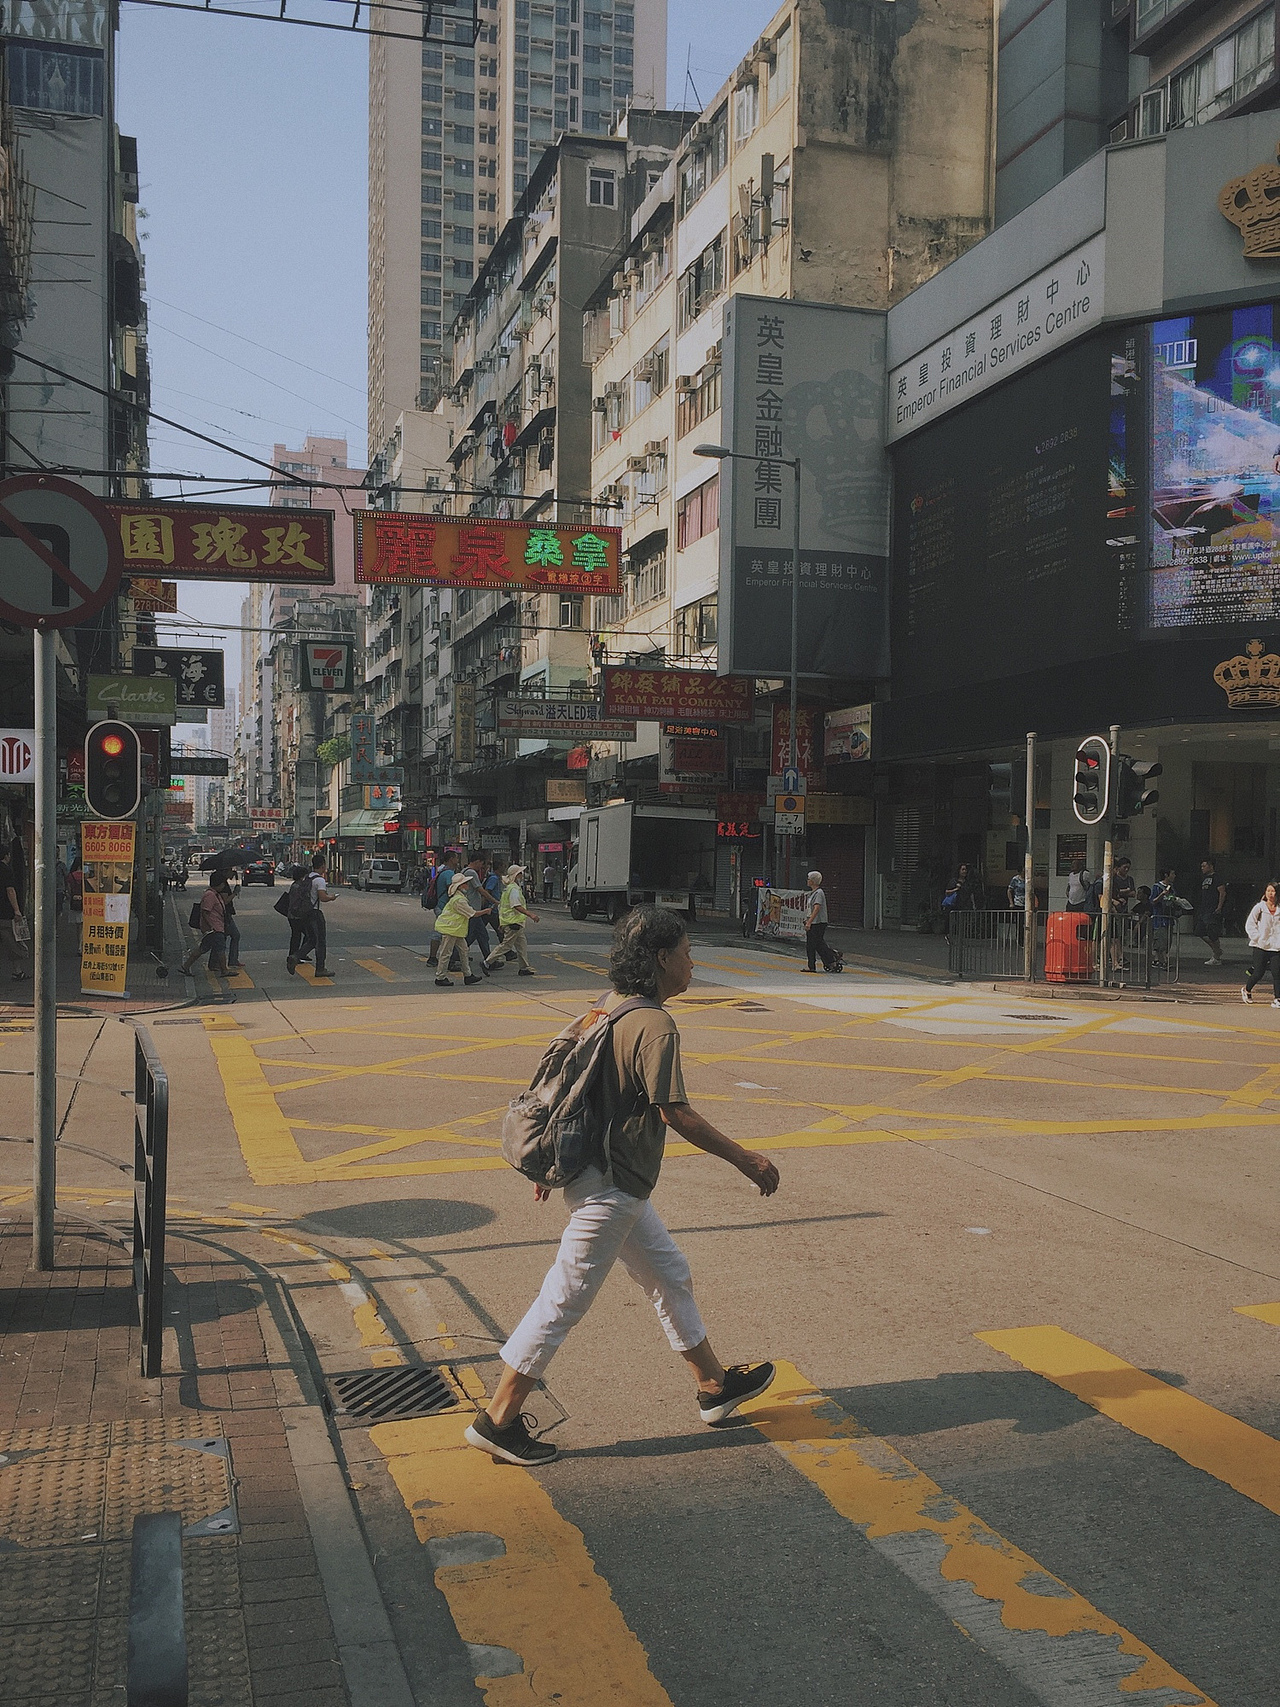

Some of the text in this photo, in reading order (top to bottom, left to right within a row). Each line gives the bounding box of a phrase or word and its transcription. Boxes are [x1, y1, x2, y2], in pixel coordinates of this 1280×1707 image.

[898, 260, 1091, 400] 英皇投資理財中心
[897, 296, 1090, 424] Emperor Financial Services Centre
[754, 315, 784, 530] 英皇金融集團
[524, 528, 610, 572] 桑拿
[751, 559, 872, 580] 英皇投資理財中心
[746, 577, 878, 593] Emperor Finncial Services Centre
[313, 649, 343, 688] 7
[98, 682, 165, 703] Clarks
[615, 694, 743, 708] KAM FAT COMPANY
[546, 704, 601, 720] 溢天LED環
[356, 719, 372, 764] 利工民
[85, 824, 133, 840] 東方酒店
[794, 826, 802, 834] 12
[85, 842, 131, 852] 6605 8066
[89, 925, 124, 939] 月租特價
